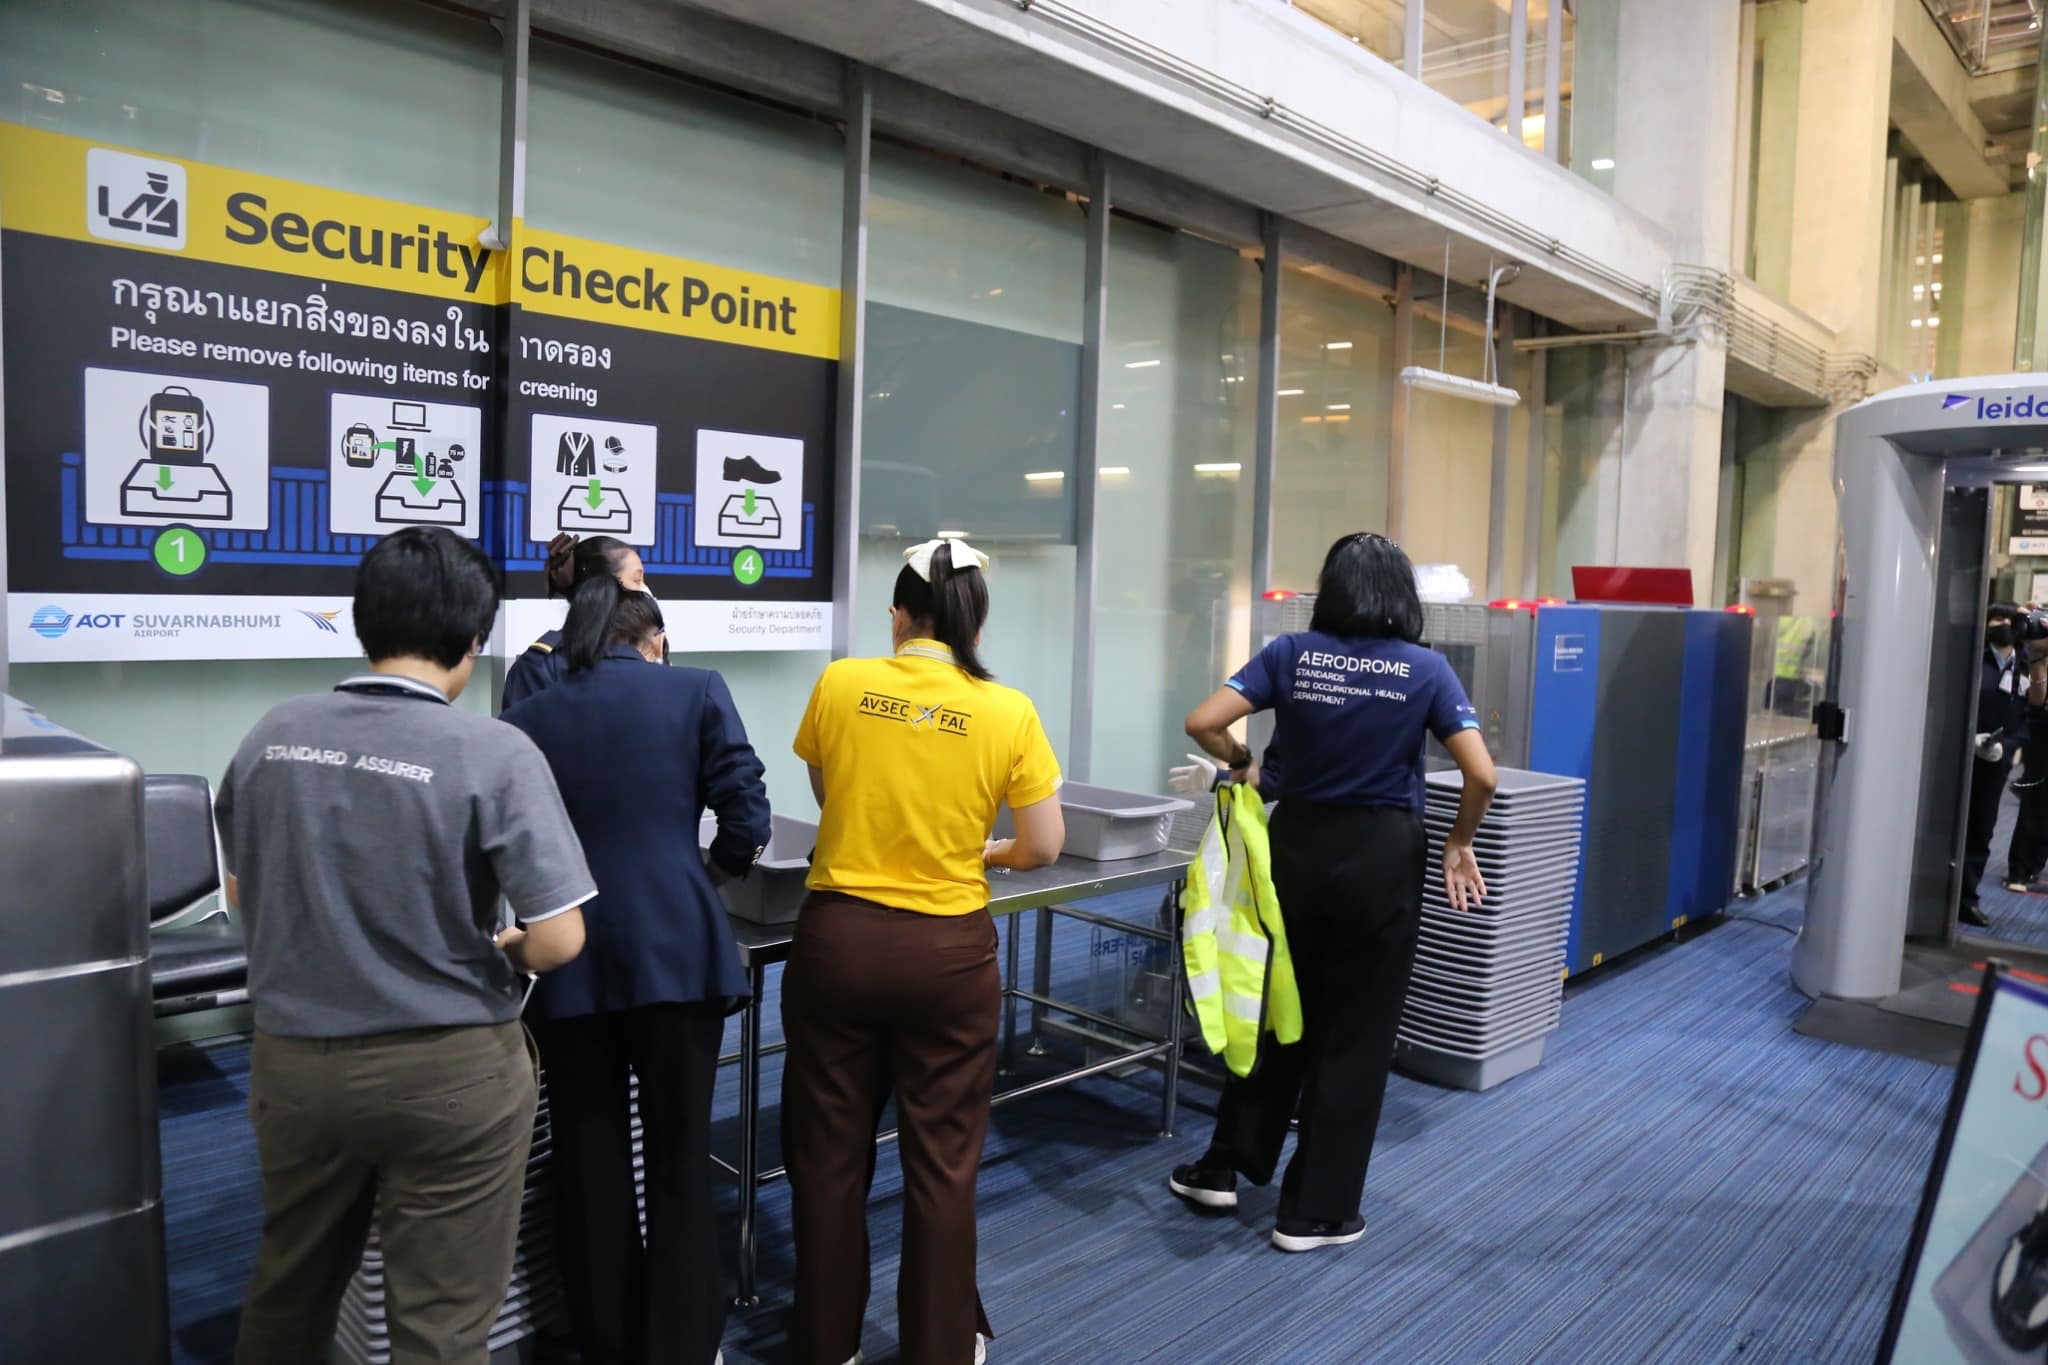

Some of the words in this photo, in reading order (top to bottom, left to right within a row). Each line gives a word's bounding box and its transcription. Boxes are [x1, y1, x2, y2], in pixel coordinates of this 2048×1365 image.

[225, 192, 492, 293] Security
[521, 247, 671, 314] Check
[681, 276, 797, 335] Point
[112, 278, 490, 353] กรุณาแยกสิ่งของลงใน
[111, 326, 197, 357] Please
[203, 342, 293, 368] remove
[298, 350, 397, 385] following
[402, 362, 458, 387] items
[462, 369, 490, 390] for
[519, 380, 598, 407] creening
[169, 535, 185, 563] 1
[740, 554, 755, 576] 4
[75, 614, 126, 628] AOT
[132, 614, 282, 629] SUVARNABHUMI
[134, 629, 180, 638] AIRPORT
[728, 623, 767, 636] Security
[768, 624, 822, 635] Department
[1295, 668, 1346, 683] STANDARDS
[1298, 650, 1411, 678] AERODROME
[1292, 691, 1347, 706] DEPARTMENT
[1294, 679, 1311, 689] AND
[1312, 681, 1372, 697] OCCUPATIONAL
[1375, 689, 1407, 703] HEALTH
[859, 696, 911, 717] AVSEC
[940, 713, 967, 731] FAL
[265, 745, 349, 766] STANDARD
[353, 754, 434, 784] ASSURER
